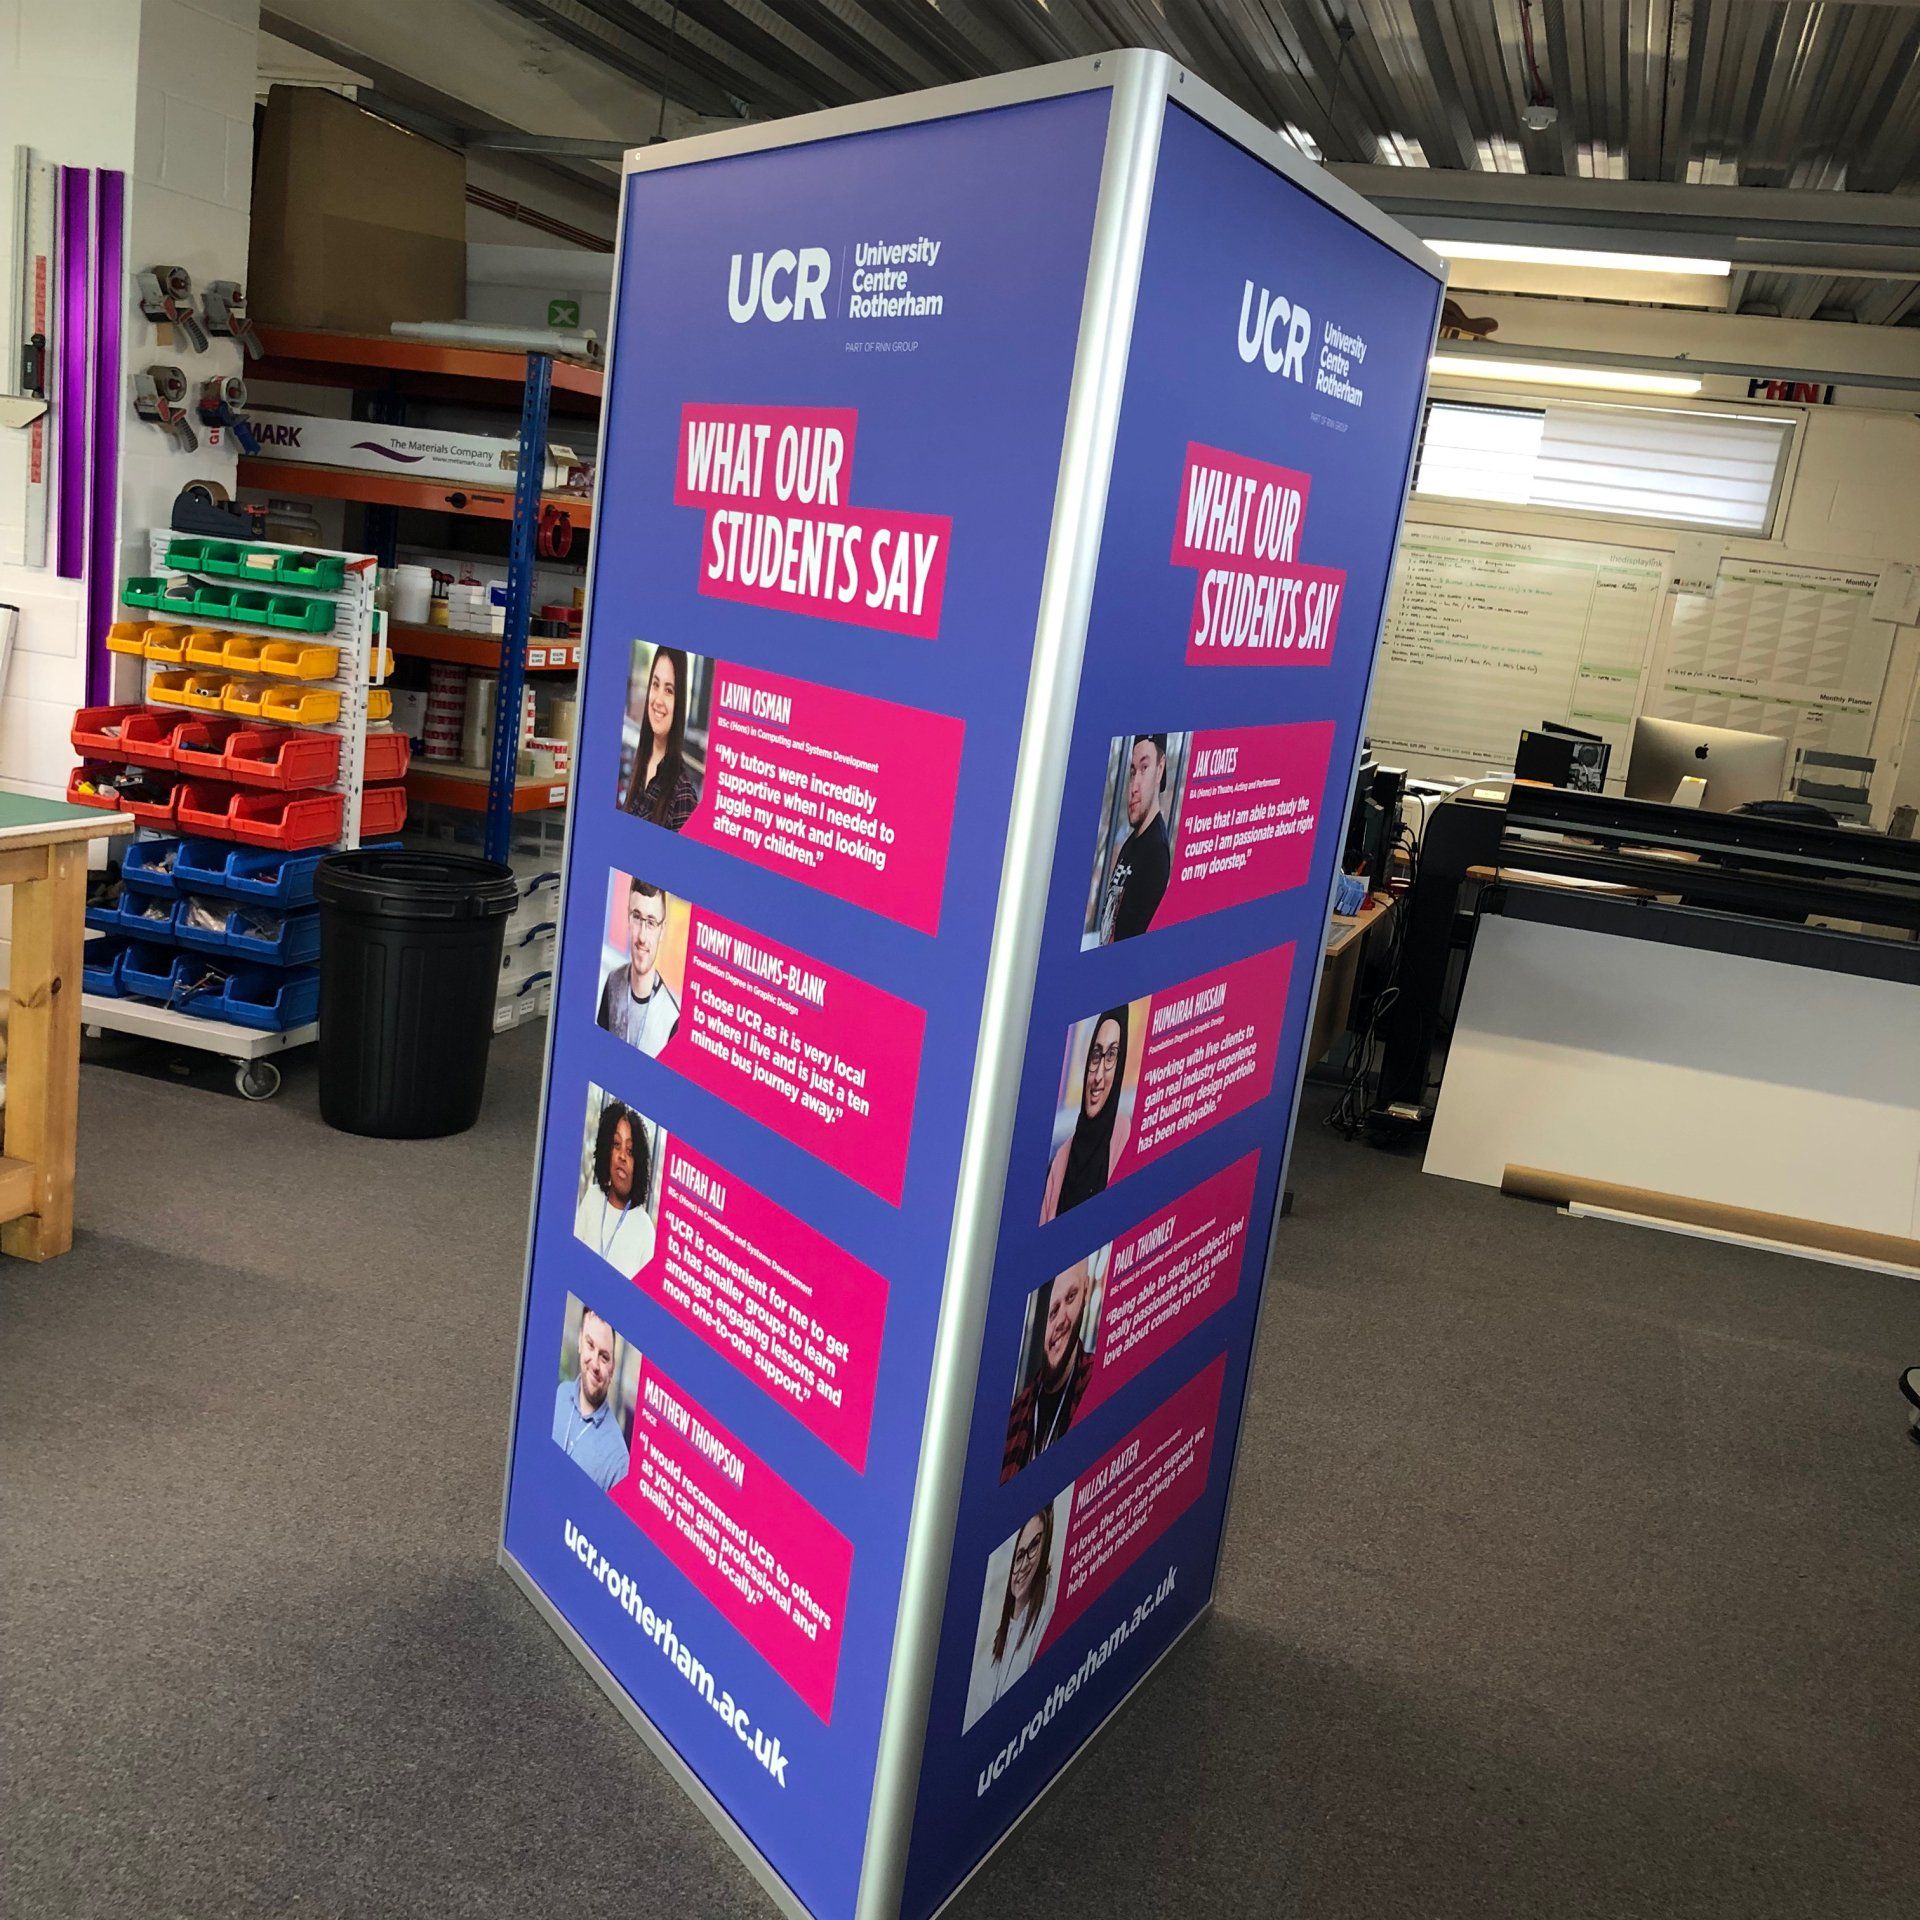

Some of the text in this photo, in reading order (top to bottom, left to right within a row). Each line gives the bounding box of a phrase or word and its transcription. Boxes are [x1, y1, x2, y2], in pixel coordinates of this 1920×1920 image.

[728, 247, 831, 324] UCR
[852, 267, 908, 293] Centre
[855, 236, 942, 274] University
[849, 290, 944, 319] Rotherham
[1237, 279, 1312, 384] UCR
[844, 341, 865, 354] PART
[873, 340, 893, 353] RNN
[890, 340, 920, 354] GROUP
[1320, 345, 1350, 378] Centre
[1322, 320, 1368, 365] University
[1315, 368, 1363, 407] Rotherham
[390, 438, 494, 461] The Materials Company
[687, 421, 844, 507] WHAT OUR
[1184, 464, 1301, 563] WHAT OUR
[708, 509, 939, 616] STUDENTS SAY
[1845, 577, 1872, 588] Monthly
[1194, 568, 1340, 650] STUDENTS SAY
[719, 680, 792, 725] LAVIN OSMAN
[1820, 693, 1873, 707] Monthly Planner
[715, 743, 877, 815] “My tutors were incredibly
[716, 715, 731, 730] BSc
[728, 720, 752, 736] (Hons)
[755, 727, 793, 750] Computing
[790, 739, 807, 752] and
[803, 741, 834, 761] Systems
[831, 749, 881, 774] Development
[1192, 747, 1239, 778] JAK COATES
[712, 814, 824, 868] after my children.”
[714, 789, 887, 871] juggle my work and looking
[718, 771, 895, 845] supportive when I needed to
[1184, 814, 1315, 858] course I am passionate about right
[1192, 814, 1213, 834] love
[1212, 810, 1232, 830] that
[1230, 809, 1236, 826] I
[1234, 809, 1250, 825] am
[1248, 803, 1267, 822] able
[1266, 802, 1277, 819] to
[1275, 797, 1298, 817] study
[1297, 795, 1310, 813] the
[692, 954, 727, 979] Foundation
[724, 970, 748, 990] Degree
[752, 984, 778, 1005] Graphic
[775, 996, 800, 1017] Design
[696, 921, 827, 1007] TOMMY WILLIAMS-BLANK
[690, 980, 866, 1088] “I chose UCR as it is very local
[1151, 982, 1227, 1036] HUMAIRAA HUSSAIN
[690, 1029, 844, 1124] minute bus journey away.”
[693, 1005, 870, 1117] to where I live and is just a ten
[670, 1153, 727, 1212] LATIFAH ALI
[1112, 1214, 1177, 1278] PAUL THORNLEY
[665, 1210, 849, 1363] “UCR is convenient for me to get
[667, 1234, 836, 1378] to, has smaller groups to learn
[662, 1277, 811, 1403] more one-to-one support.”
[664, 1257, 843, 1408] amongst, engaging lessons and
[640, 1406, 659, 1428] PGCE
[644, 1377, 745, 1487] MATTHEW THOMPSON
[1075, 1439, 1140, 1514] MILLISA BAXTER
[639, 1431, 832, 1631] “I would recommend UCR to others
[639, 1478, 764, 1605] quality training locally.”
[641, 1458, 818, 1642] as you can gain professional and
[564, 1518, 789, 1788] ucr.rotherham.ac.uk
[977, 1565, 1178, 1797] ucr.rotherham.ac.uk
